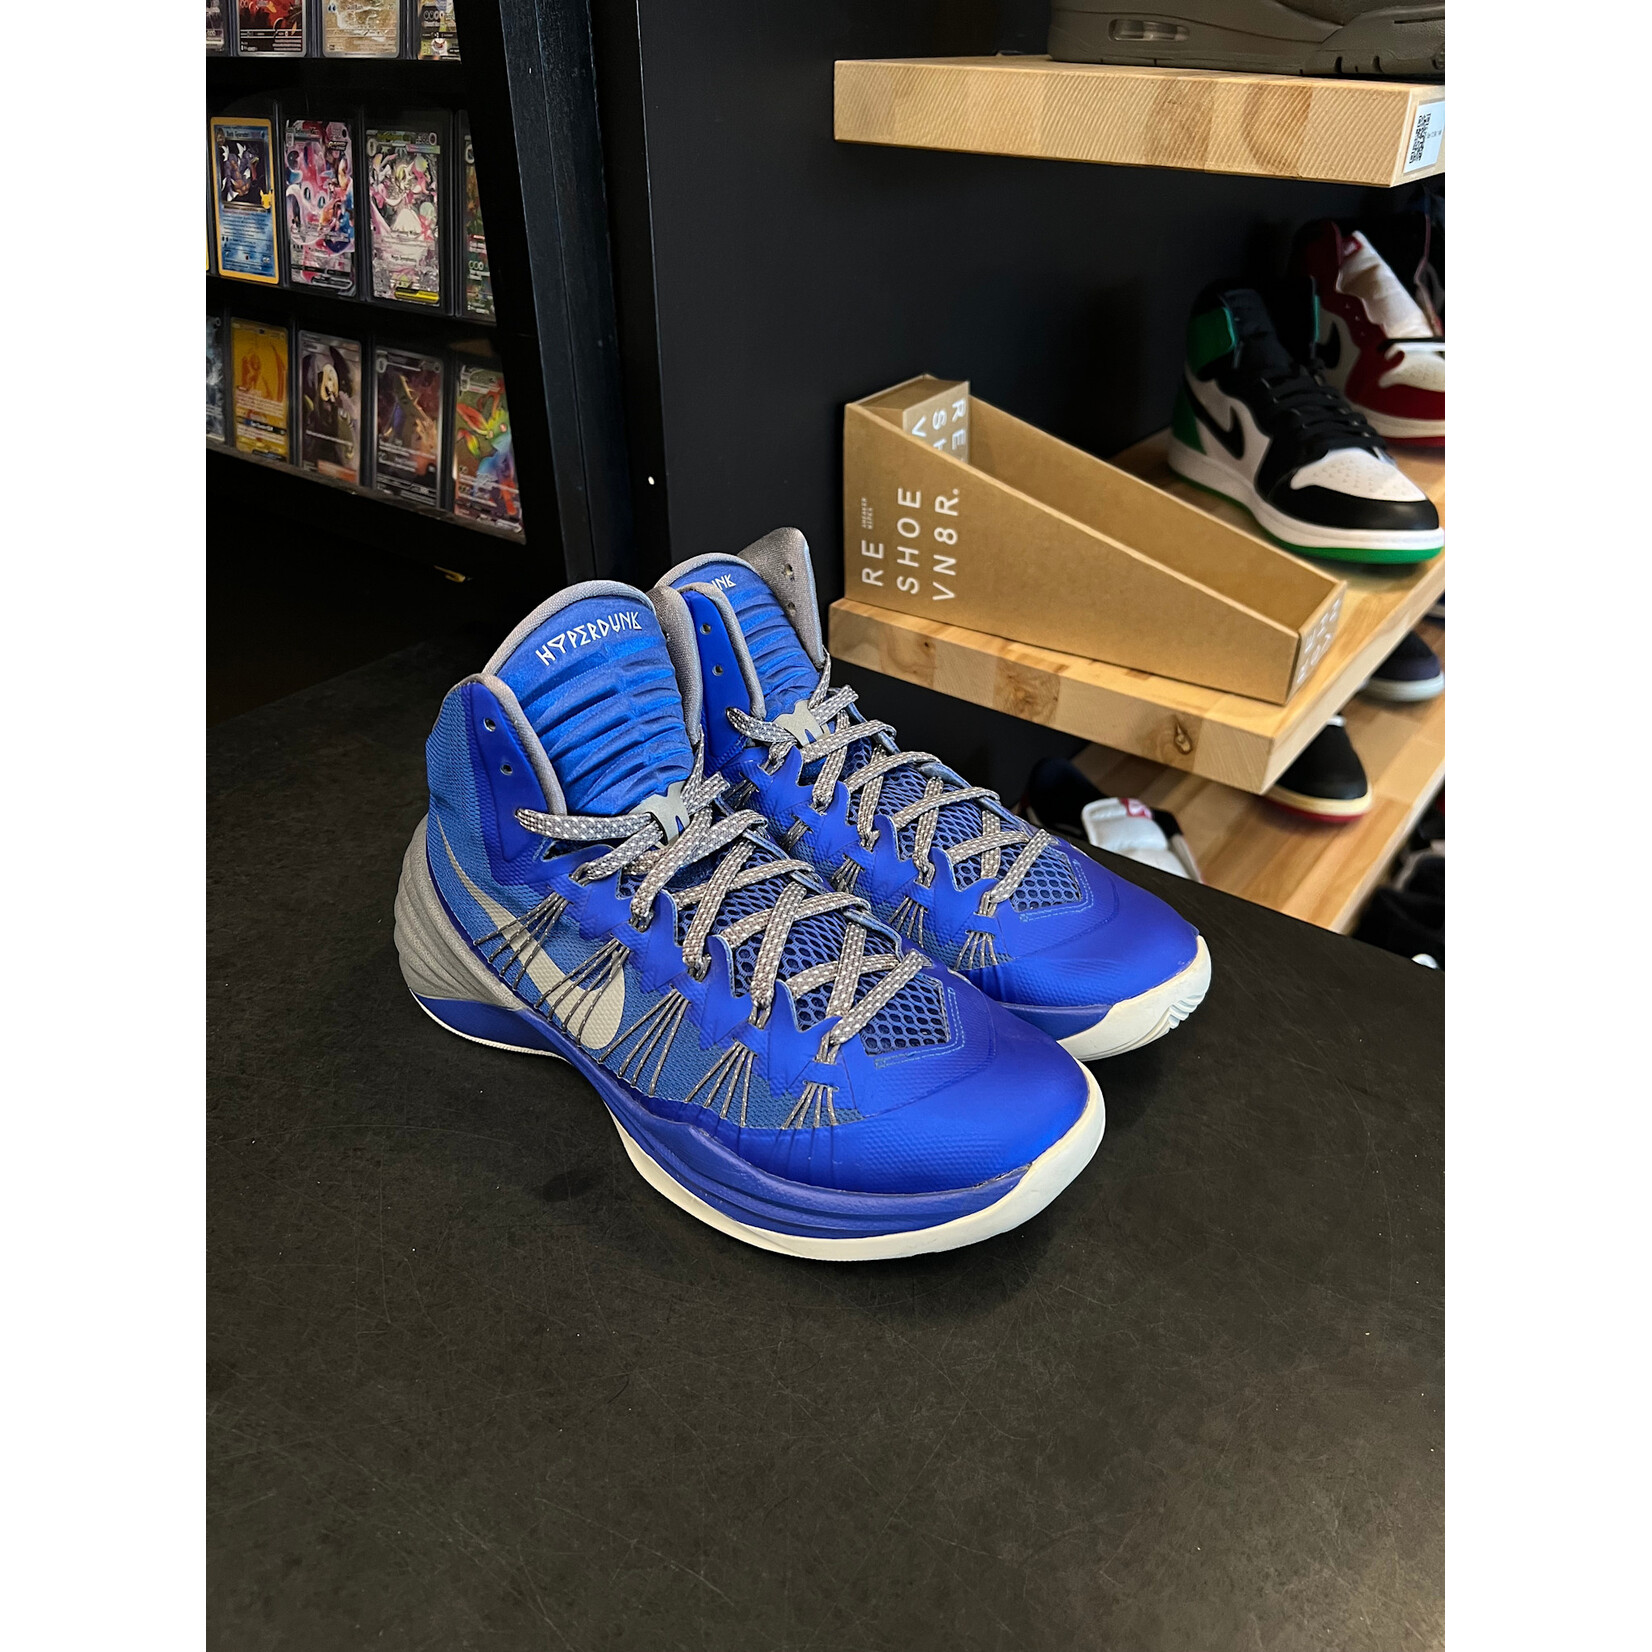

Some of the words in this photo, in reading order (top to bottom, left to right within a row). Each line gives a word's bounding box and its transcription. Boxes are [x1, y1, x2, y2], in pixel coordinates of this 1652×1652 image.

[952, 398, 966, 451] RE
[861, 539, 884, 587] RE
[896, 488, 921, 595] SHOE
[932, 488, 960, 601] VN8R.
[535, 611, 643, 666] HYPERDUNK
